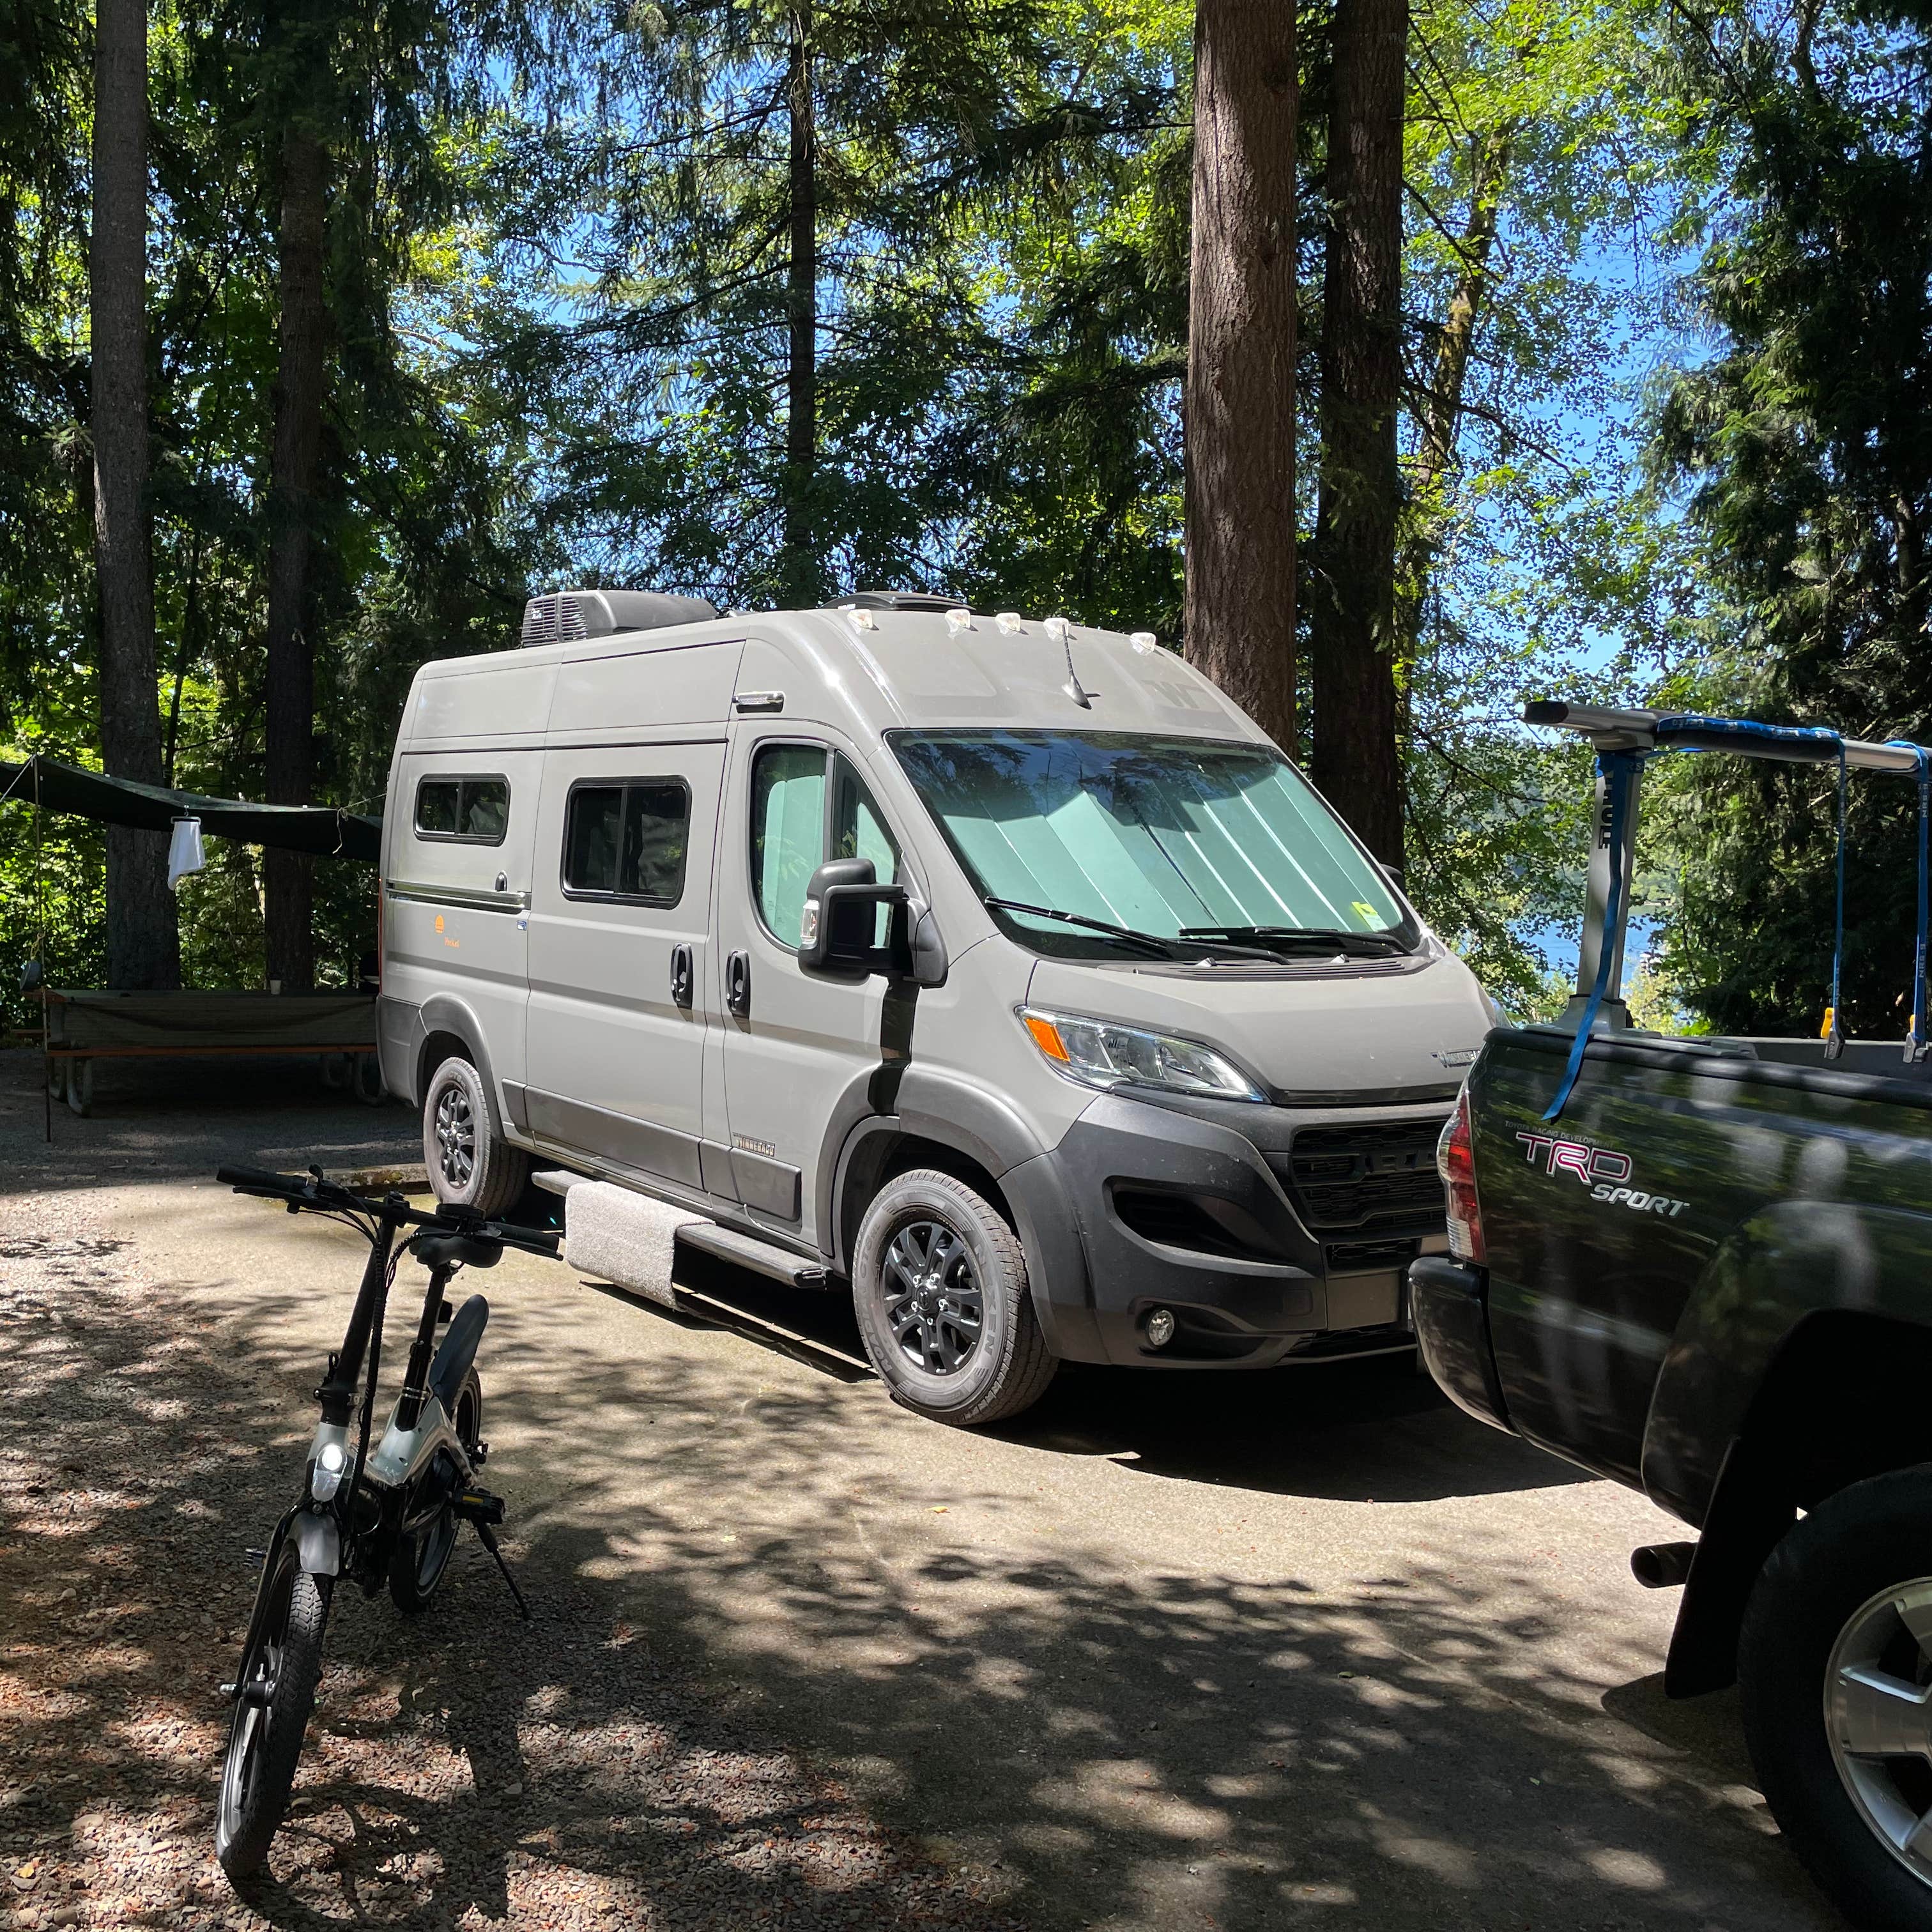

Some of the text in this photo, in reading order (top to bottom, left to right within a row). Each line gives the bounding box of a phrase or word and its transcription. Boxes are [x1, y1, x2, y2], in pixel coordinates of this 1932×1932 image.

[1505, 1120, 1530, 1131] TOYOTA
[1531, 1126, 1559, 1138] RACING
[1515, 1131, 1634, 1186] TRD
[1590, 1183, 1691, 1218] SPORT
[973, 1243, 997, 1356] NXEN
